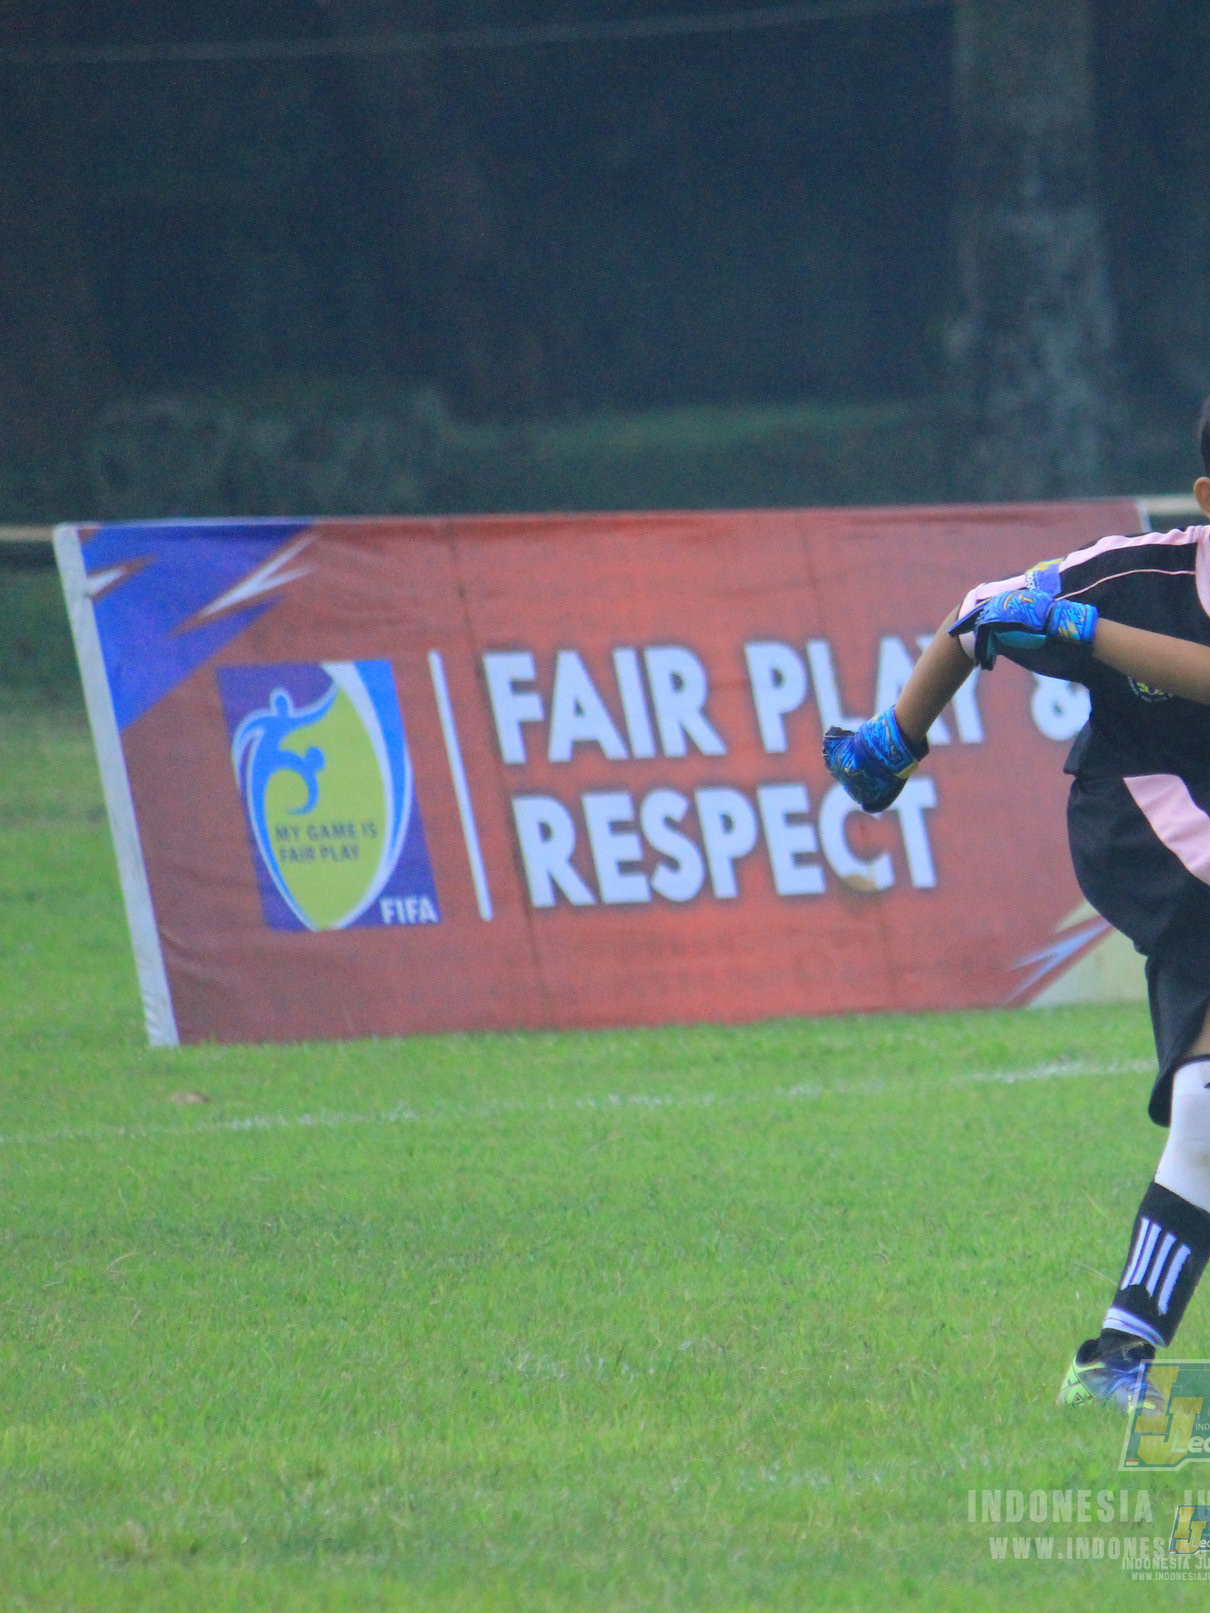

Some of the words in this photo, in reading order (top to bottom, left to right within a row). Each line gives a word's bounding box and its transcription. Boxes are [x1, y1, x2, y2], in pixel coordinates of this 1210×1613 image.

[482, 644, 727, 765] FAIR
[275, 823, 303, 841] MY
[306, 821, 356, 842] GAME
[361, 821, 378, 839] IS
[510, 776, 937, 908] RESPECT
[279, 845, 316, 863] FAIR
[319, 842, 360, 861] PLAY
[379, 895, 438, 925] FIFA
